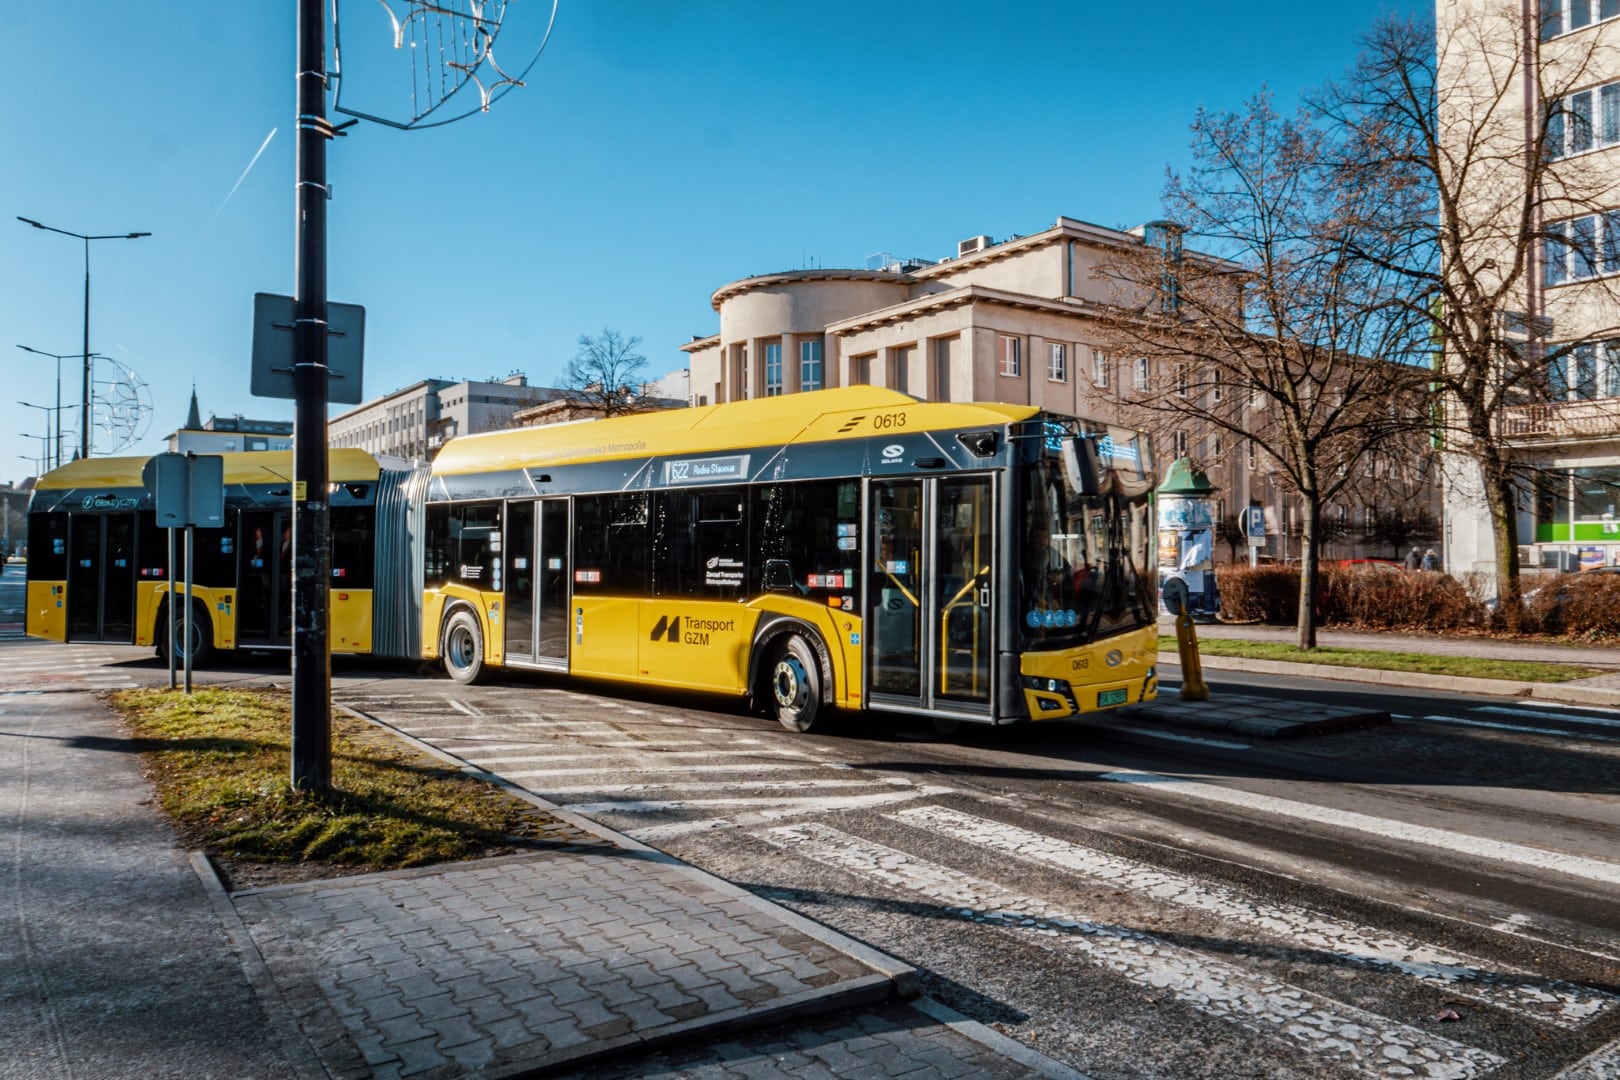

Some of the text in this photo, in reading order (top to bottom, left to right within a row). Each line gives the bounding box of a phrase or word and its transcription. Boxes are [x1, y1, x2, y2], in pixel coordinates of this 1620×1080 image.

[873, 412, 906, 429] 0613
[608, 440, 647, 453] Metropolia
[672, 462, 689, 479] 622
[1251, 509, 1261, 529] P
[684, 616, 735, 632] Transport
[684, 632, 709, 645] GZM
[1072, 658, 1089, 671] 0613
